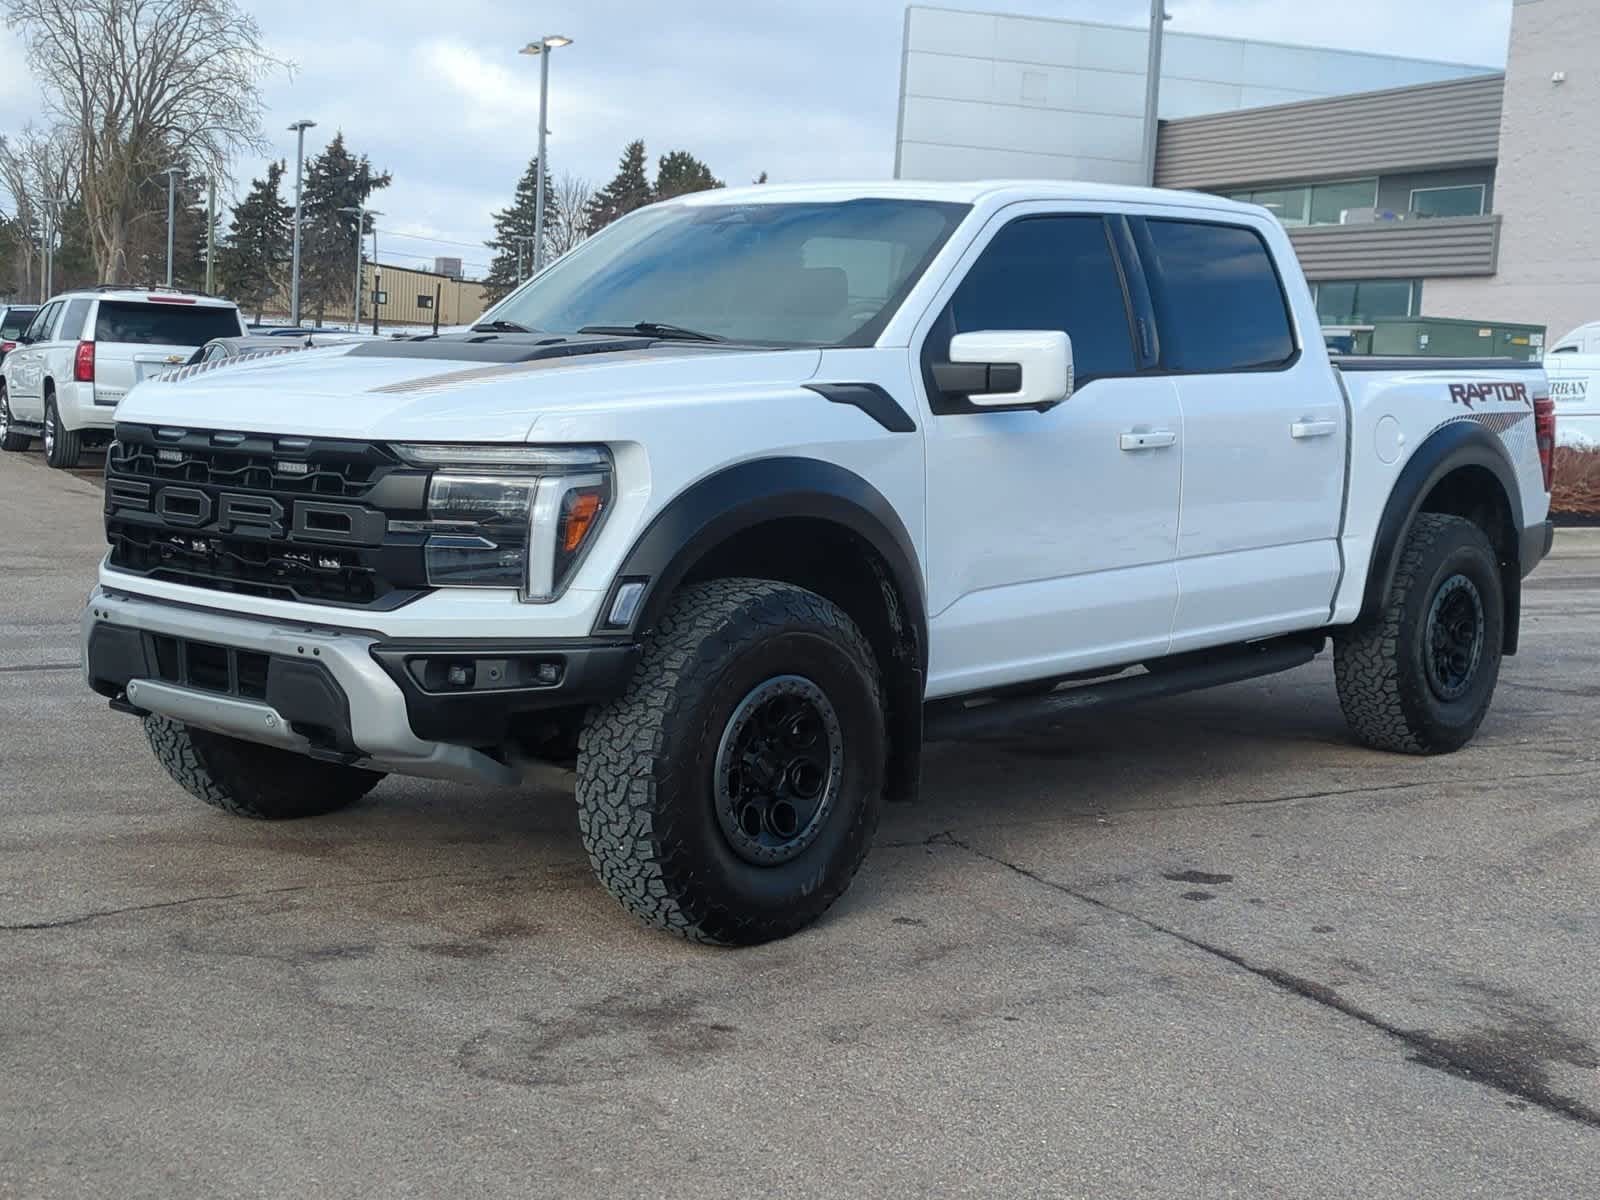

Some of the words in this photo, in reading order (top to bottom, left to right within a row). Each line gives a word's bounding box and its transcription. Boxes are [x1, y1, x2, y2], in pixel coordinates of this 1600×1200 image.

[1448, 382, 1532, 411] RAPTOR
[1549, 381, 1588, 395] RBAN
[106, 477, 386, 546] FORD
